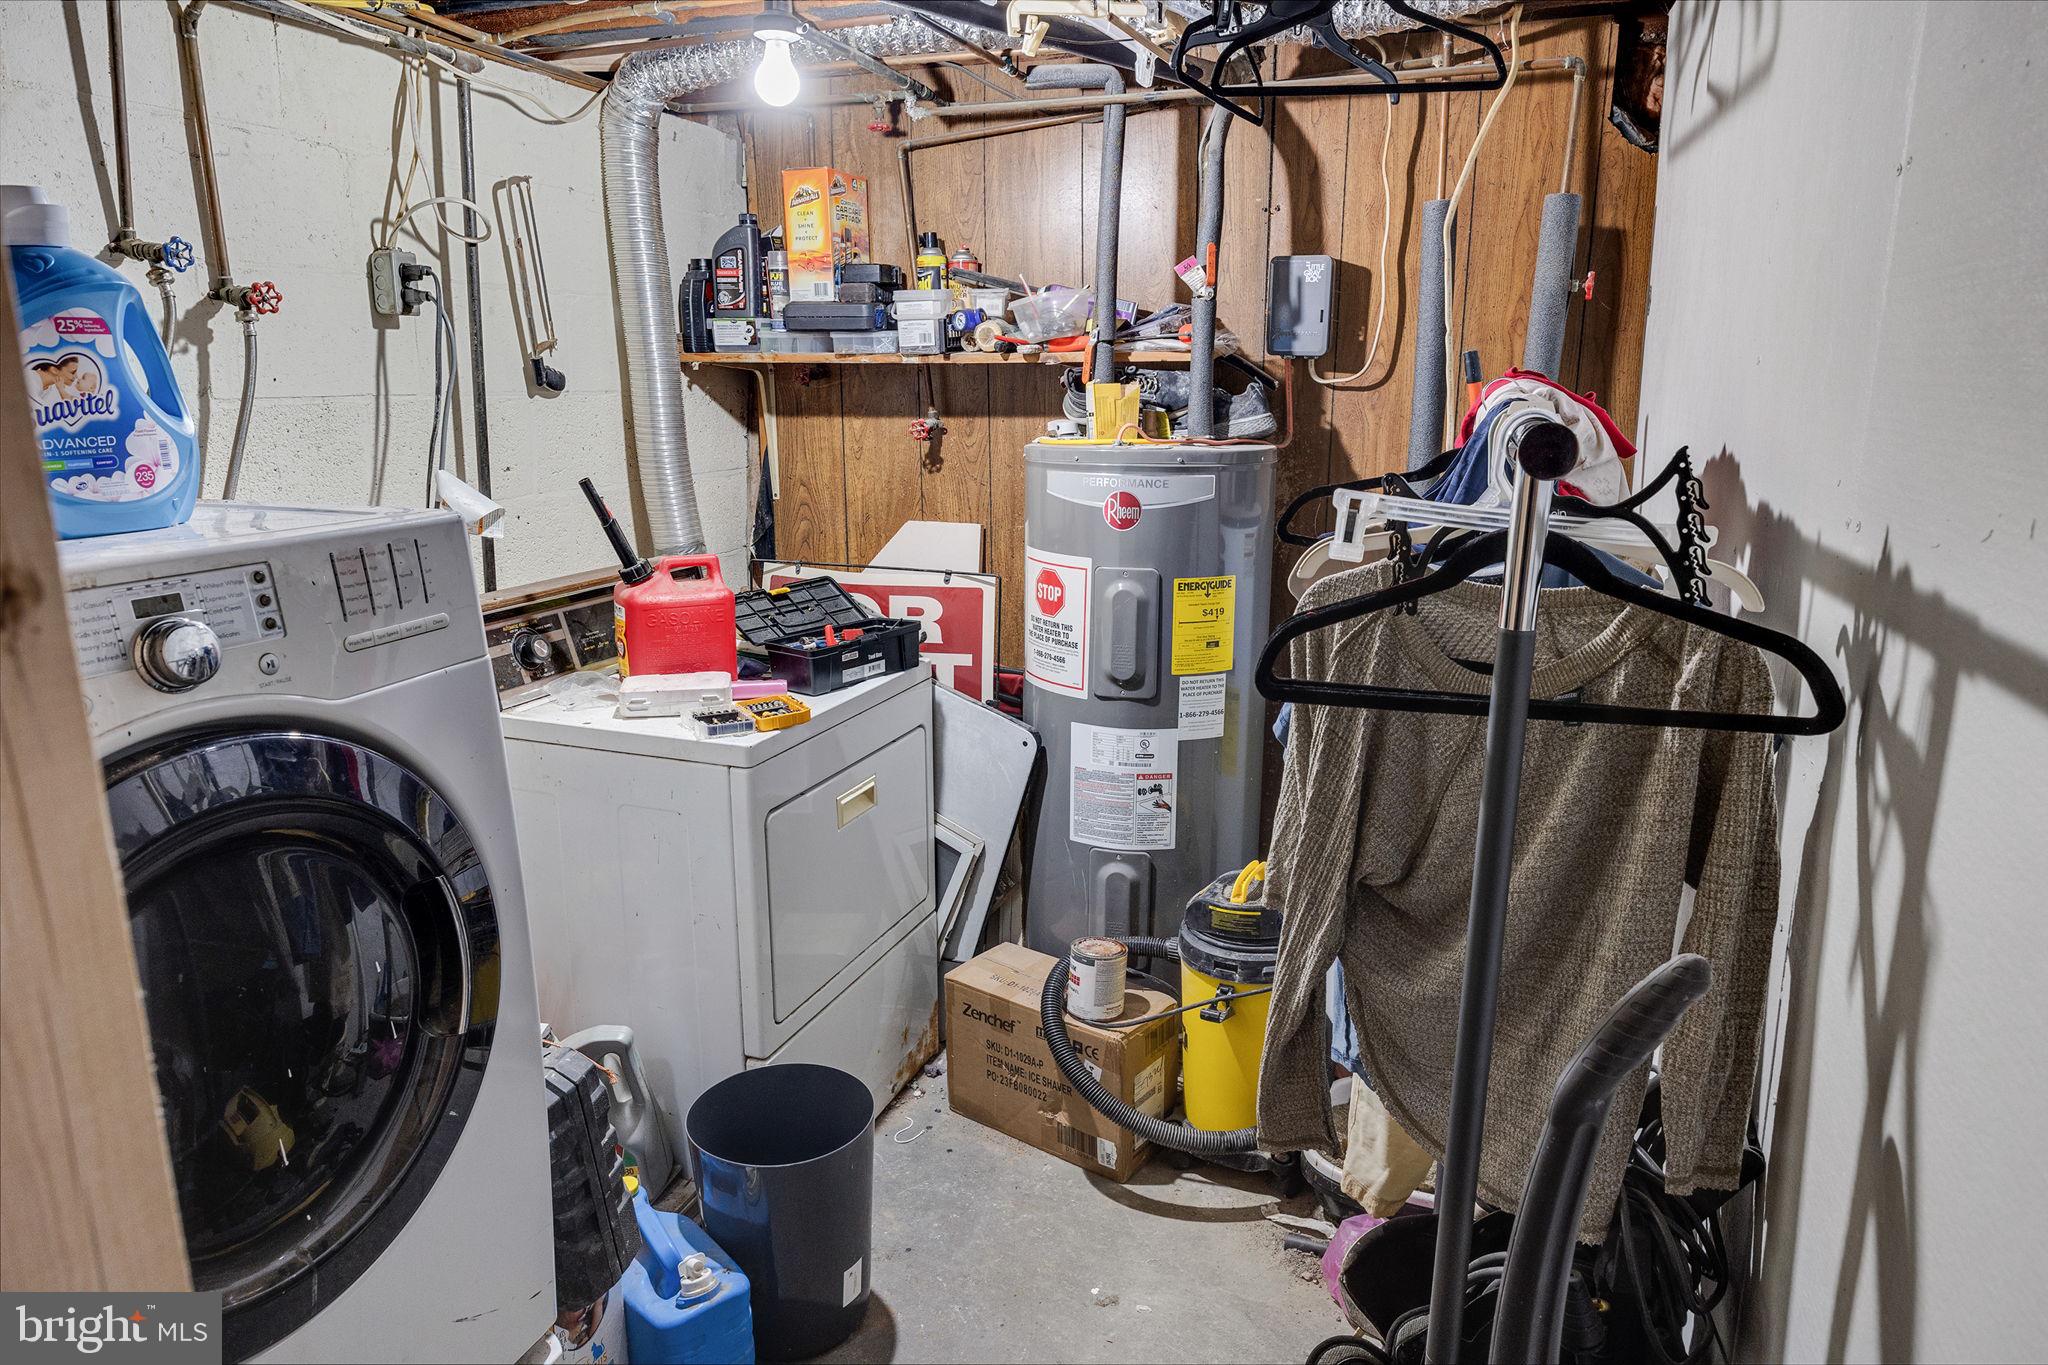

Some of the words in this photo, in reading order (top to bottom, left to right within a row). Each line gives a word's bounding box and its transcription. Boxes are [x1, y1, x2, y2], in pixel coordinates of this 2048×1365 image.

[56, 319, 83, 332] 25%
[35, 389, 114, 426] uavitel
[135, 471, 154, 482] 235
[1082, 477, 1170, 489] PERFORMANCE
[1107, 491, 1140, 525] Rheem
[1037, 582, 1062, 602] STOP
[1177, 579, 1232, 592] ENERGYGUIDE
[647, 607, 725, 627] GASOLINE
[1202, 607, 1225, 617] $419
[1032, 624, 1044, 634] WATER
[1044, 626, 1061, 638] HEATER
[1062, 631, 1070, 639] TO
[1035, 616, 1043, 624] NOT
[1042, 618, 1060, 630] RETURN
[1061, 623, 1073, 632] THIS
[218, 631, 241, 639] elicates
[1033, 630, 1045, 642] PLACE
[1045, 635, 1051, 643] OF
[1051, 637, 1079, 650] PURCHASE
[101, 642, 117, 650] Duty
[962, 1001, 1017, 1034] Zenchef
[985, 1039, 1003, 1054] SKU:
[1006, 1062, 1028, 1079] NAME:
[1028, 1071, 1041, 1084] ICE
[1042, 1076, 1073, 1097] SHAVER
